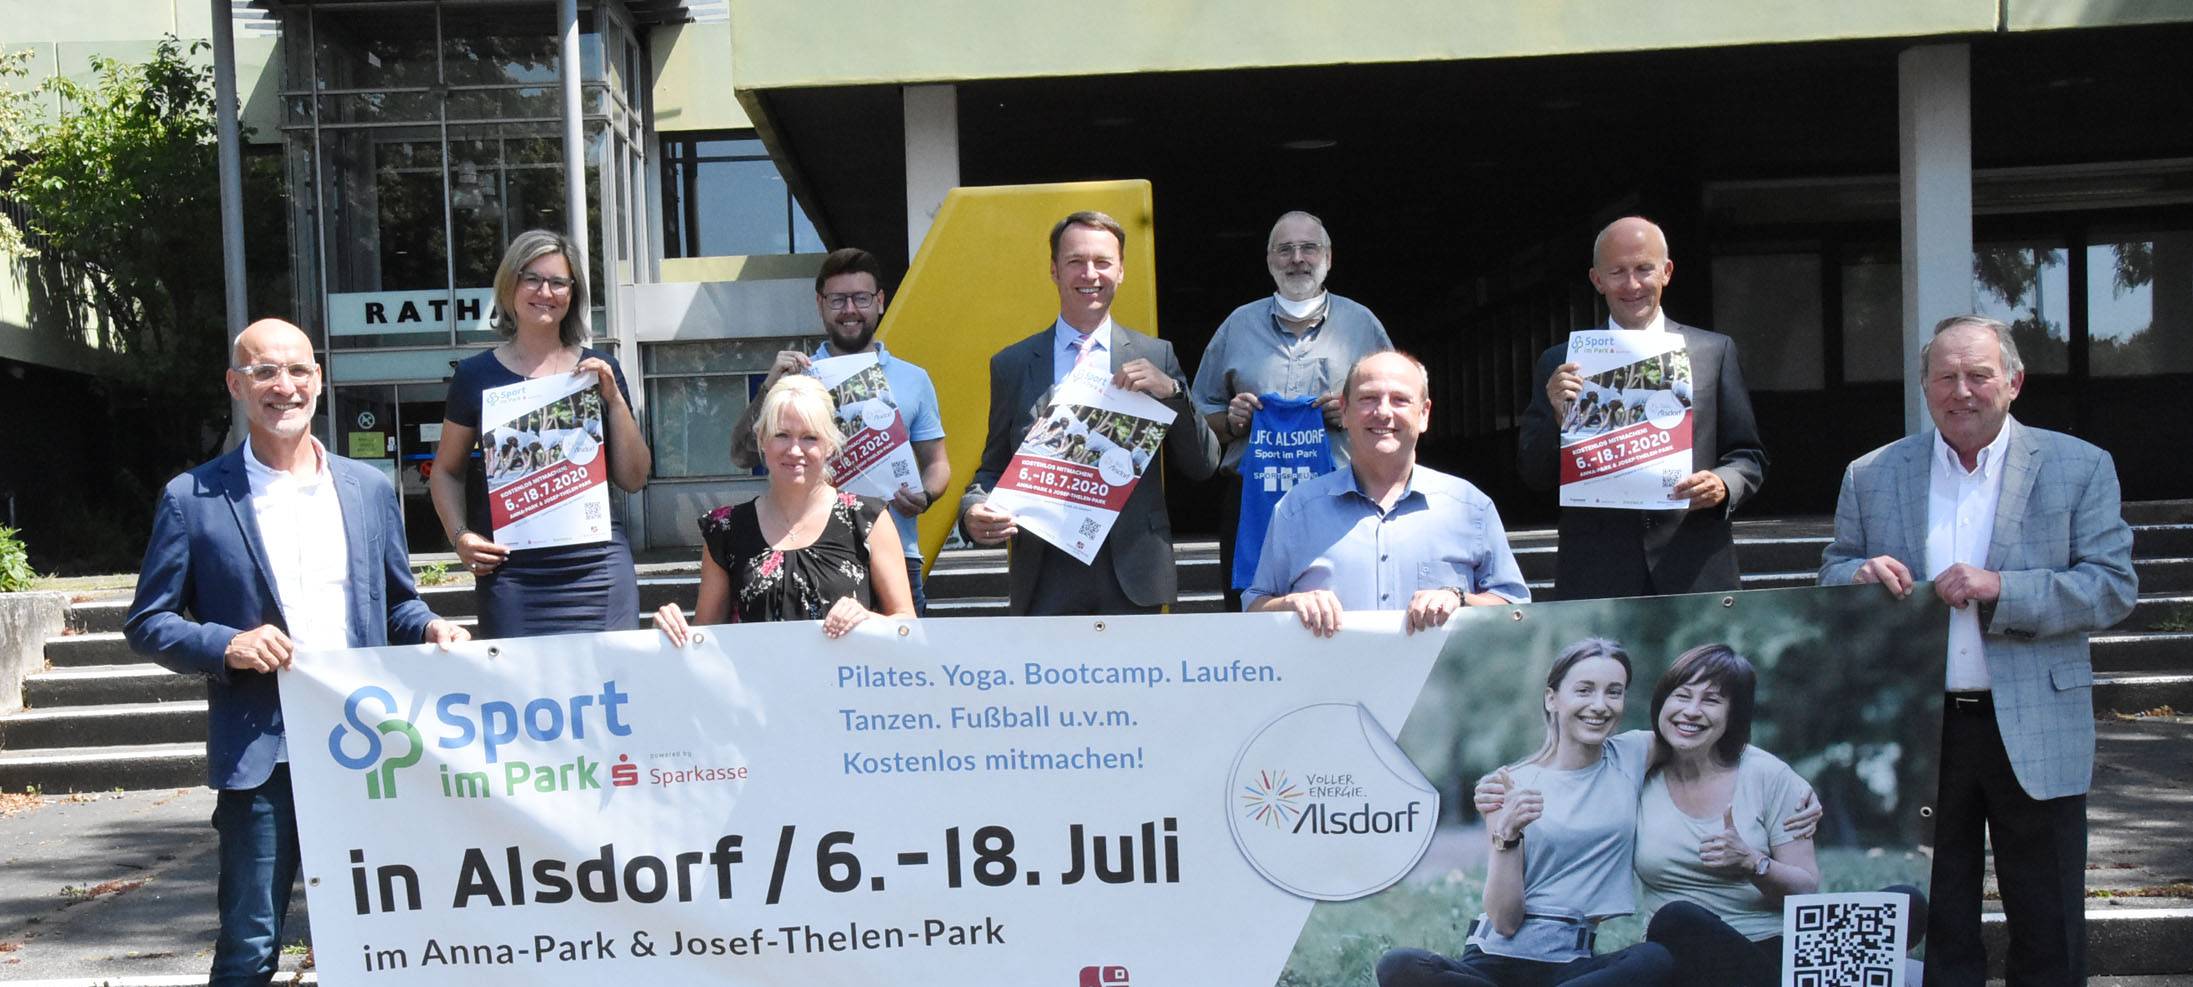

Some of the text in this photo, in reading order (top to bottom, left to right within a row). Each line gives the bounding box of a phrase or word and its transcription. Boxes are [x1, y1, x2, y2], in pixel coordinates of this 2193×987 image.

[1585, 336, 1615, 348] Sport
[1275, 428, 1325, 447] ALSDORF
[1254, 448, 1318, 459] Sport im Park
[837, 659, 1283, 691] Pilates. Yoga. Bootcamp. Laufen.
[436, 680, 632, 763] Sport
[839, 705, 1139, 732] Tanzen. Fußball u.v.m.
[649, 751, 681, 760] powered
[843, 745, 1144, 775] Kostenlos mitmachen!
[439, 755, 601, 799] im Park
[649, 765, 749, 788] Sparkasse
[1306, 774, 1355, 786] VOLLER
[1309, 786, 1368, 799] ENERGIE.
[1292, 801, 1421, 835] Alsdorf
[349, 848, 422, 916] in
[453, 834, 744, 909] Alsdorf
[1061, 817, 1181, 885] Juli
[363, 917, 1006, 972] im Anna-Park & Josef-Thelen-Park
